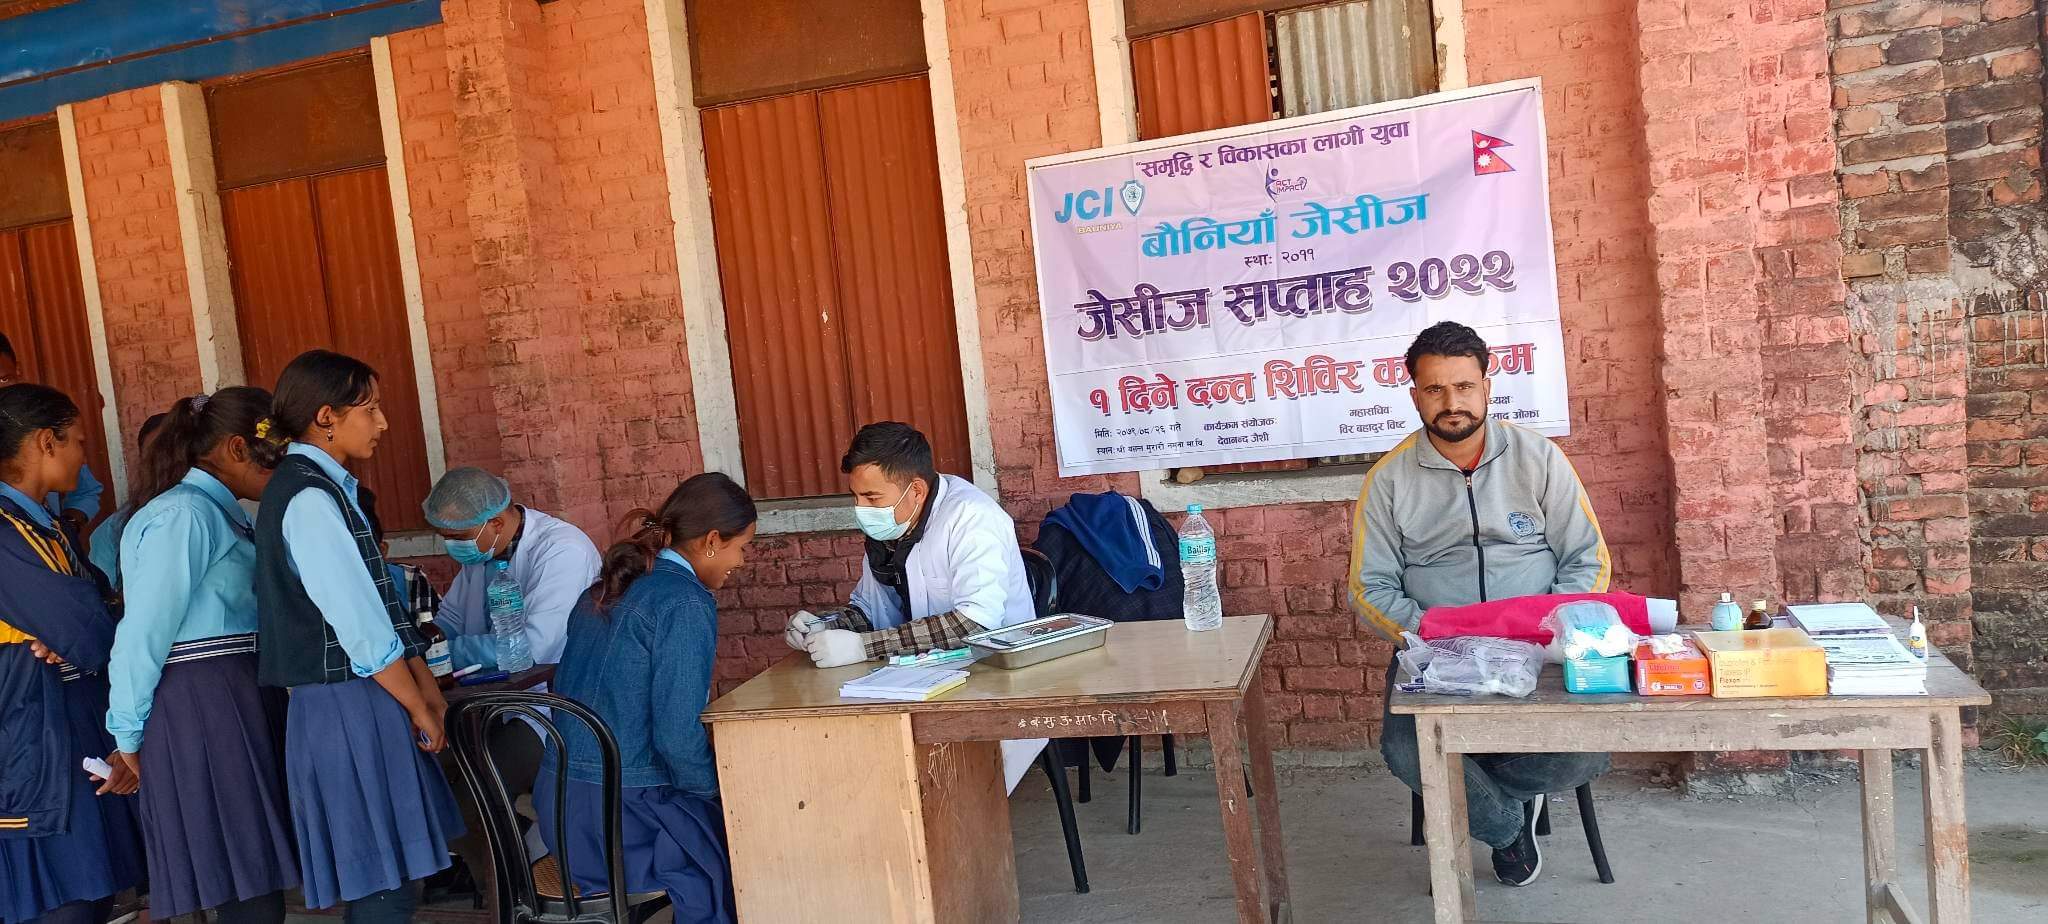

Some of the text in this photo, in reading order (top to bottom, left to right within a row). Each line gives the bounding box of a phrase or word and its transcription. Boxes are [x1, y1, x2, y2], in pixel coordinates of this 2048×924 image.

[1200, 153, 1212, 169] र
[1218, 138, 1307, 166] विकासका
[1313, 125, 1364, 152] लागी
[1370, 120, 1410, 145] युवा
[1055, 187, 1113, 223] JCI
[1141, 193, 1430, 257] बौनियाँ जेसीज
[1077, 223, 1123, 235] BAUNIYA
[1282, 248, 1315, 264] २०११
[1074, 250, 1517, 341] जेसीज सप्ताह २०२२
[1089, 387, 1111, 416] १
[1118, 373, 1179, 415] दिने
[1185, 372, 1256, 409] दन्त
[1264, 354, 1365, 402] शिविर
[1203, 420, 1239, 431] कार्यक्रम
